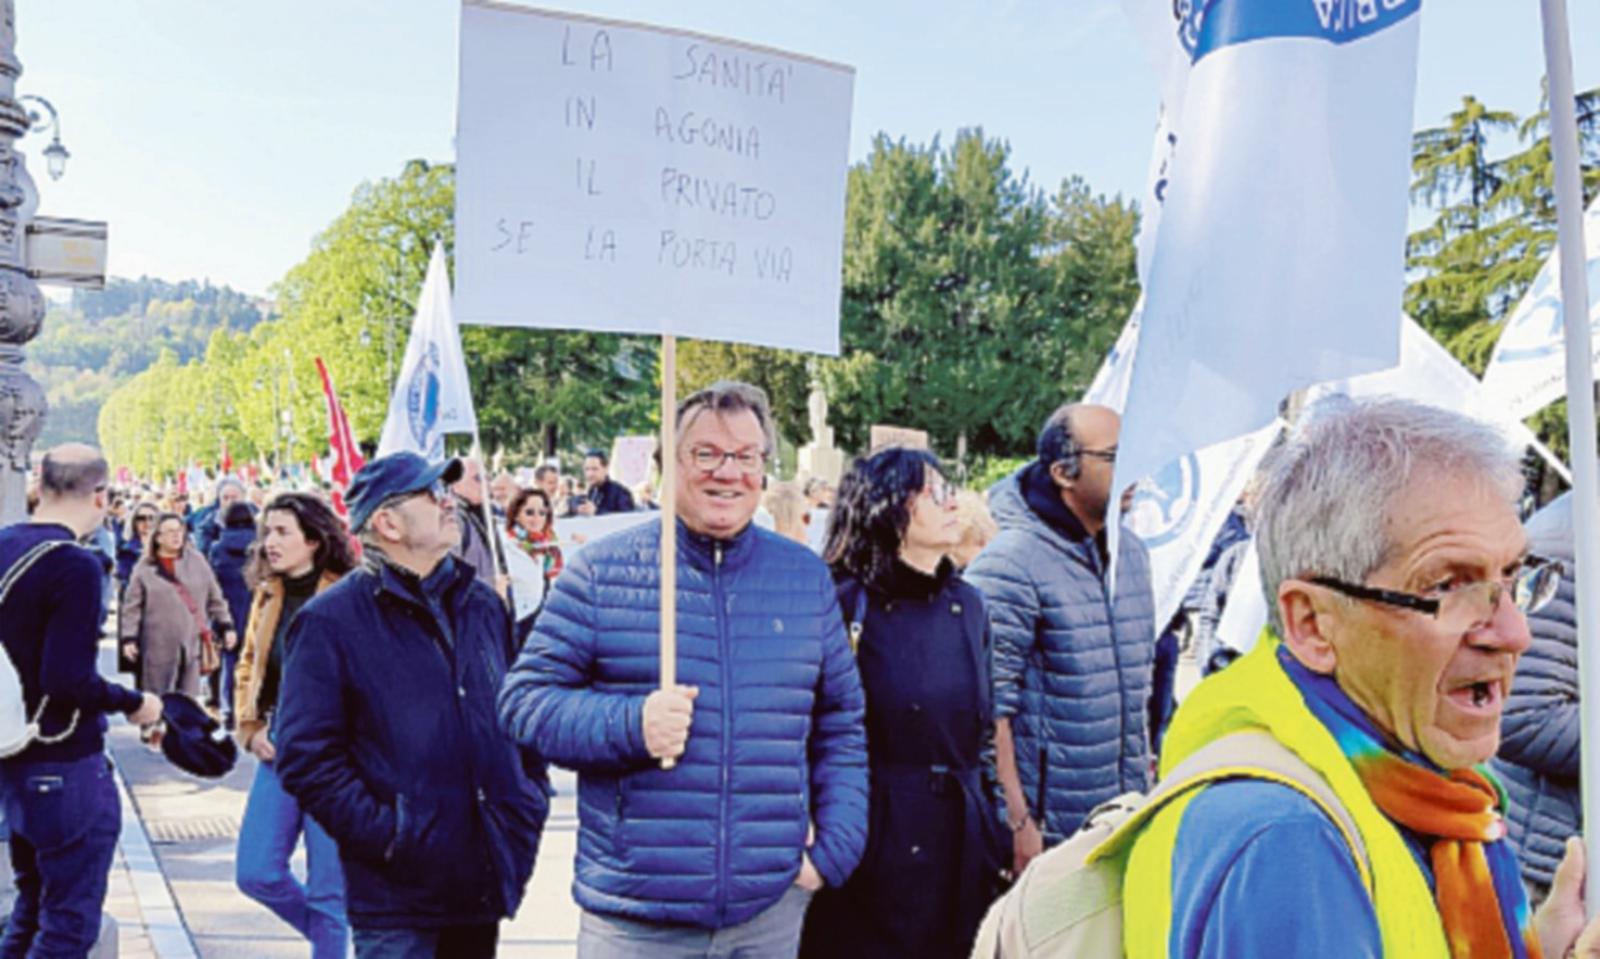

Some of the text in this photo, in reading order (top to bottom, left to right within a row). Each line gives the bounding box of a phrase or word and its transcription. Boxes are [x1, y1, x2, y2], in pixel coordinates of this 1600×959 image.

[561, 24, 793, 104] LA SANITA'
[565, 96, 760, 159] IN AGONIA
[576, 157, 776, 221] IL PRIVATO
[491, 218, 793, 283] SE LA PORTA VIA
